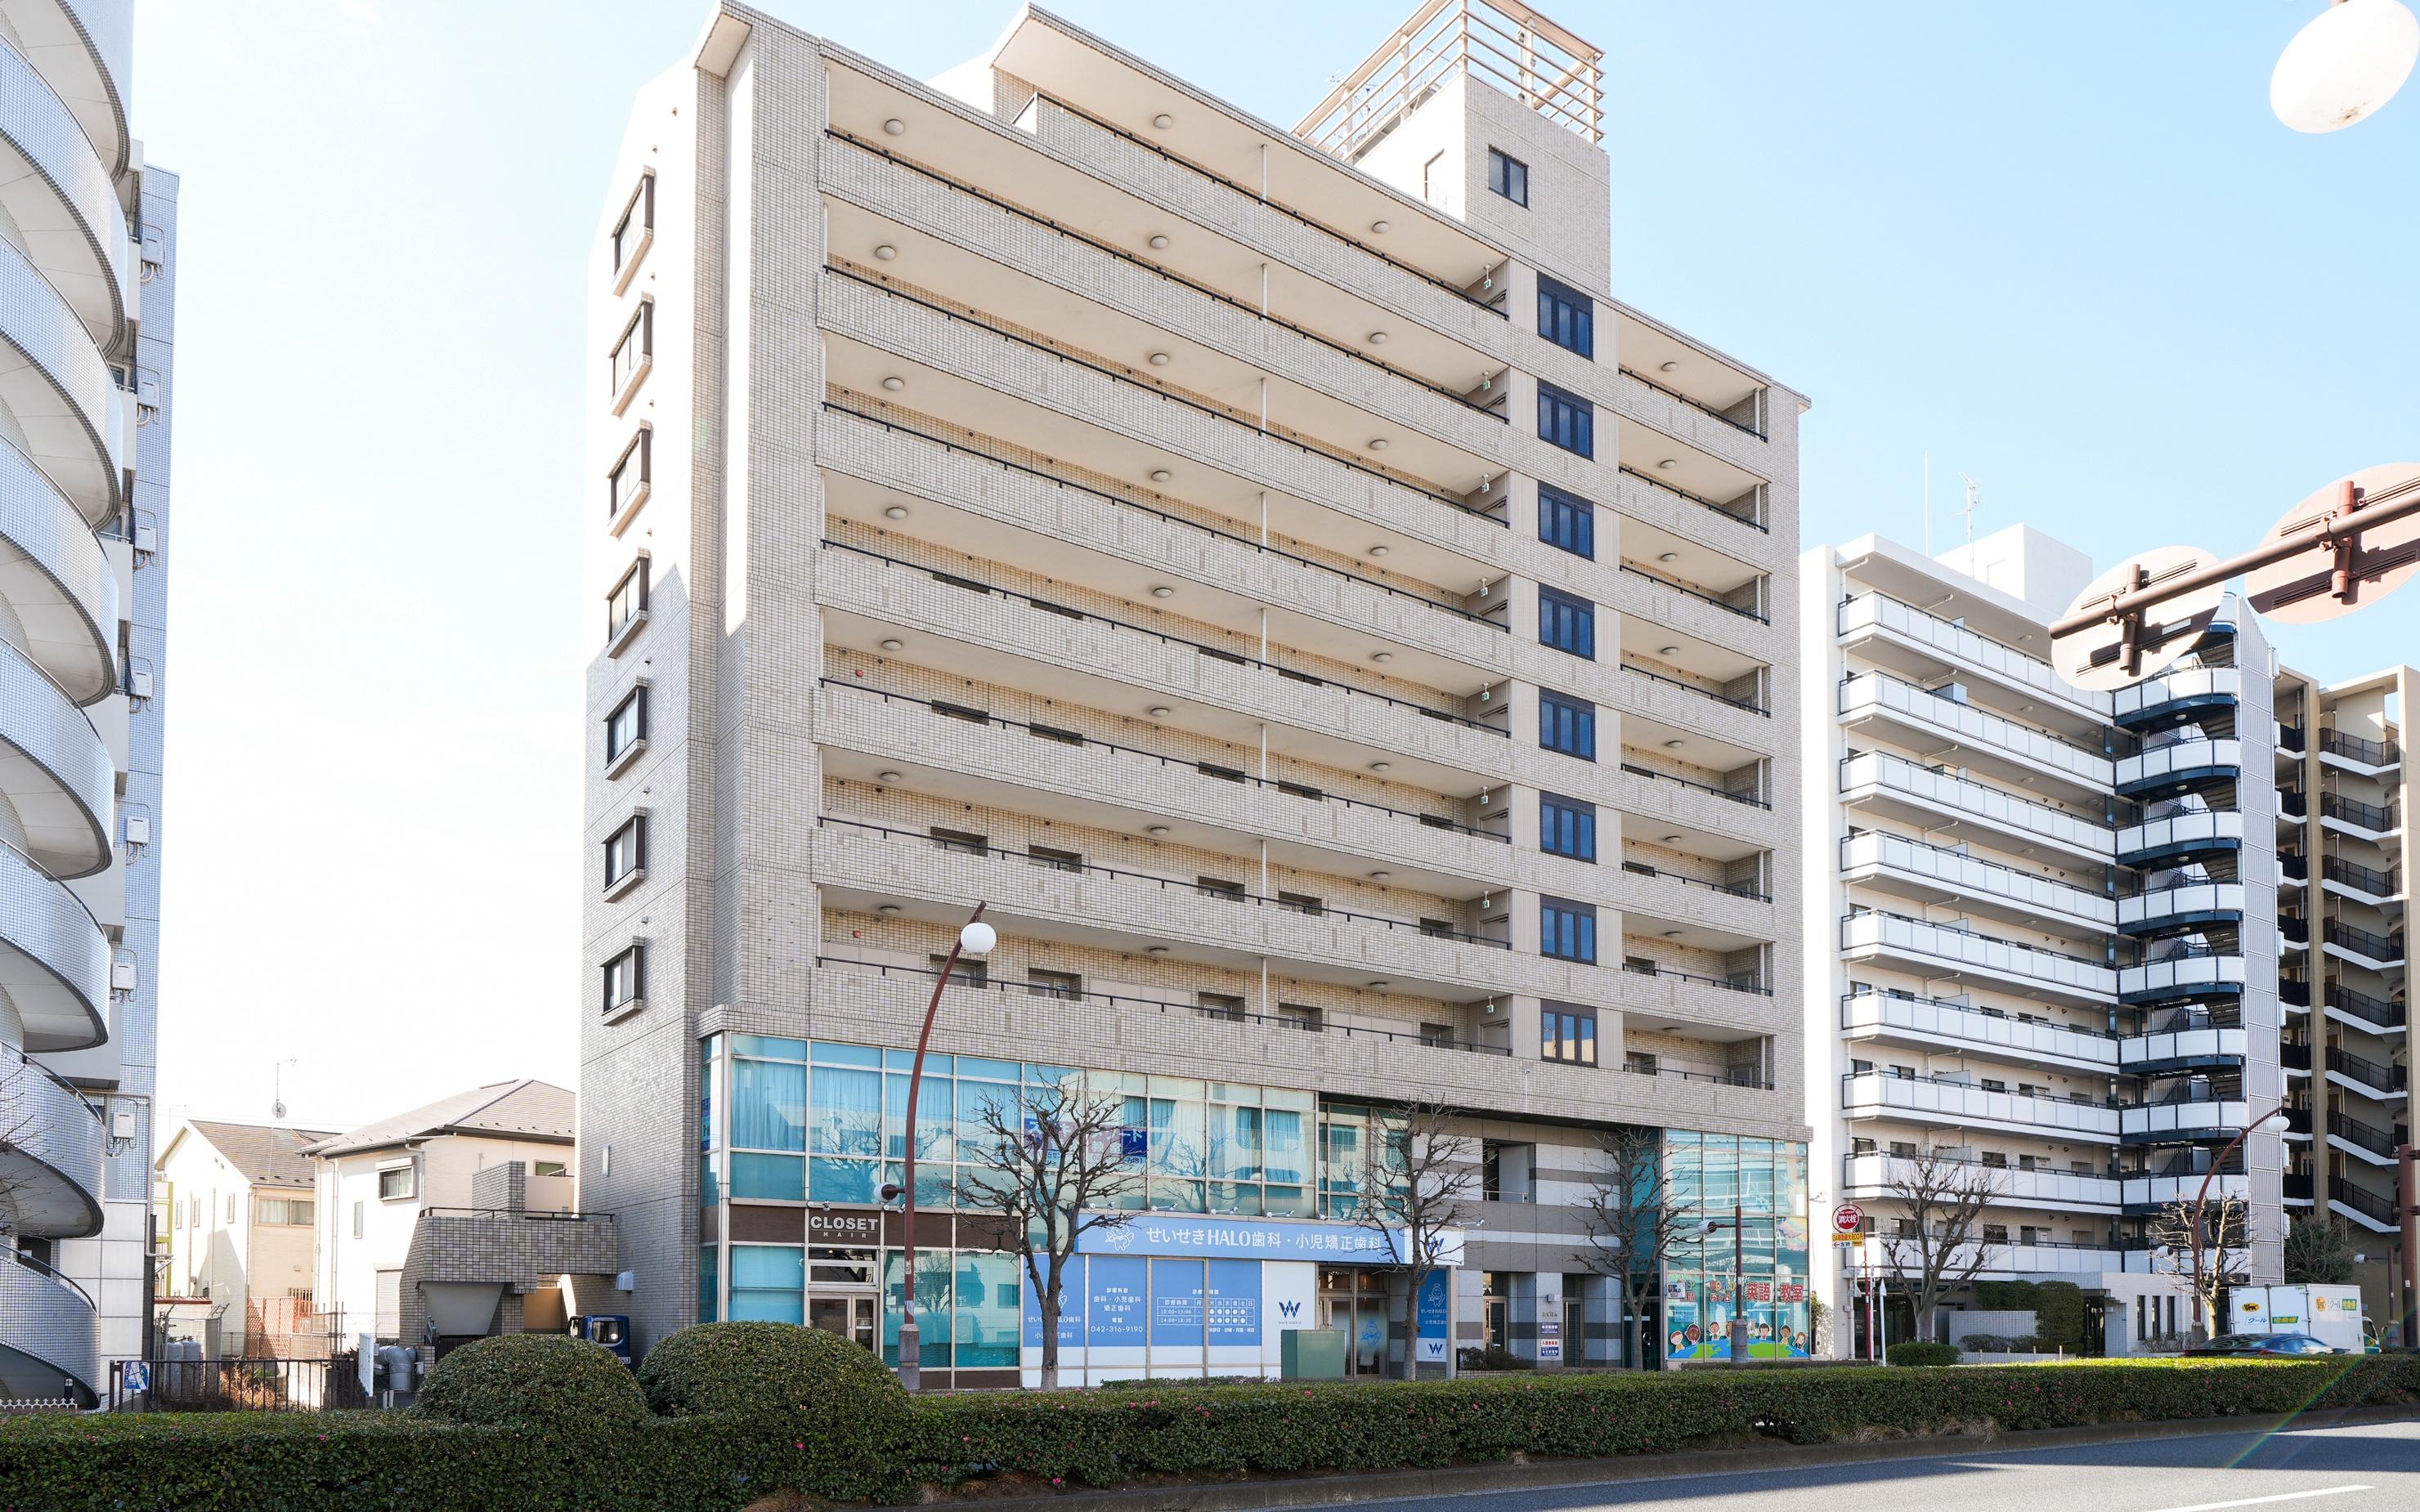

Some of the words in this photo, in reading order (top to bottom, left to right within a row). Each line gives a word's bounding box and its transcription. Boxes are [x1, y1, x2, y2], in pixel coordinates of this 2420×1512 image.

[810, 1216, 878, 1230] CLOSET
[1838, 1215, 1857, 1223] 消火栓
[1746, 1282, 1771, 1301] 英語
[1781, 1282, 1804, 1302] 教室
